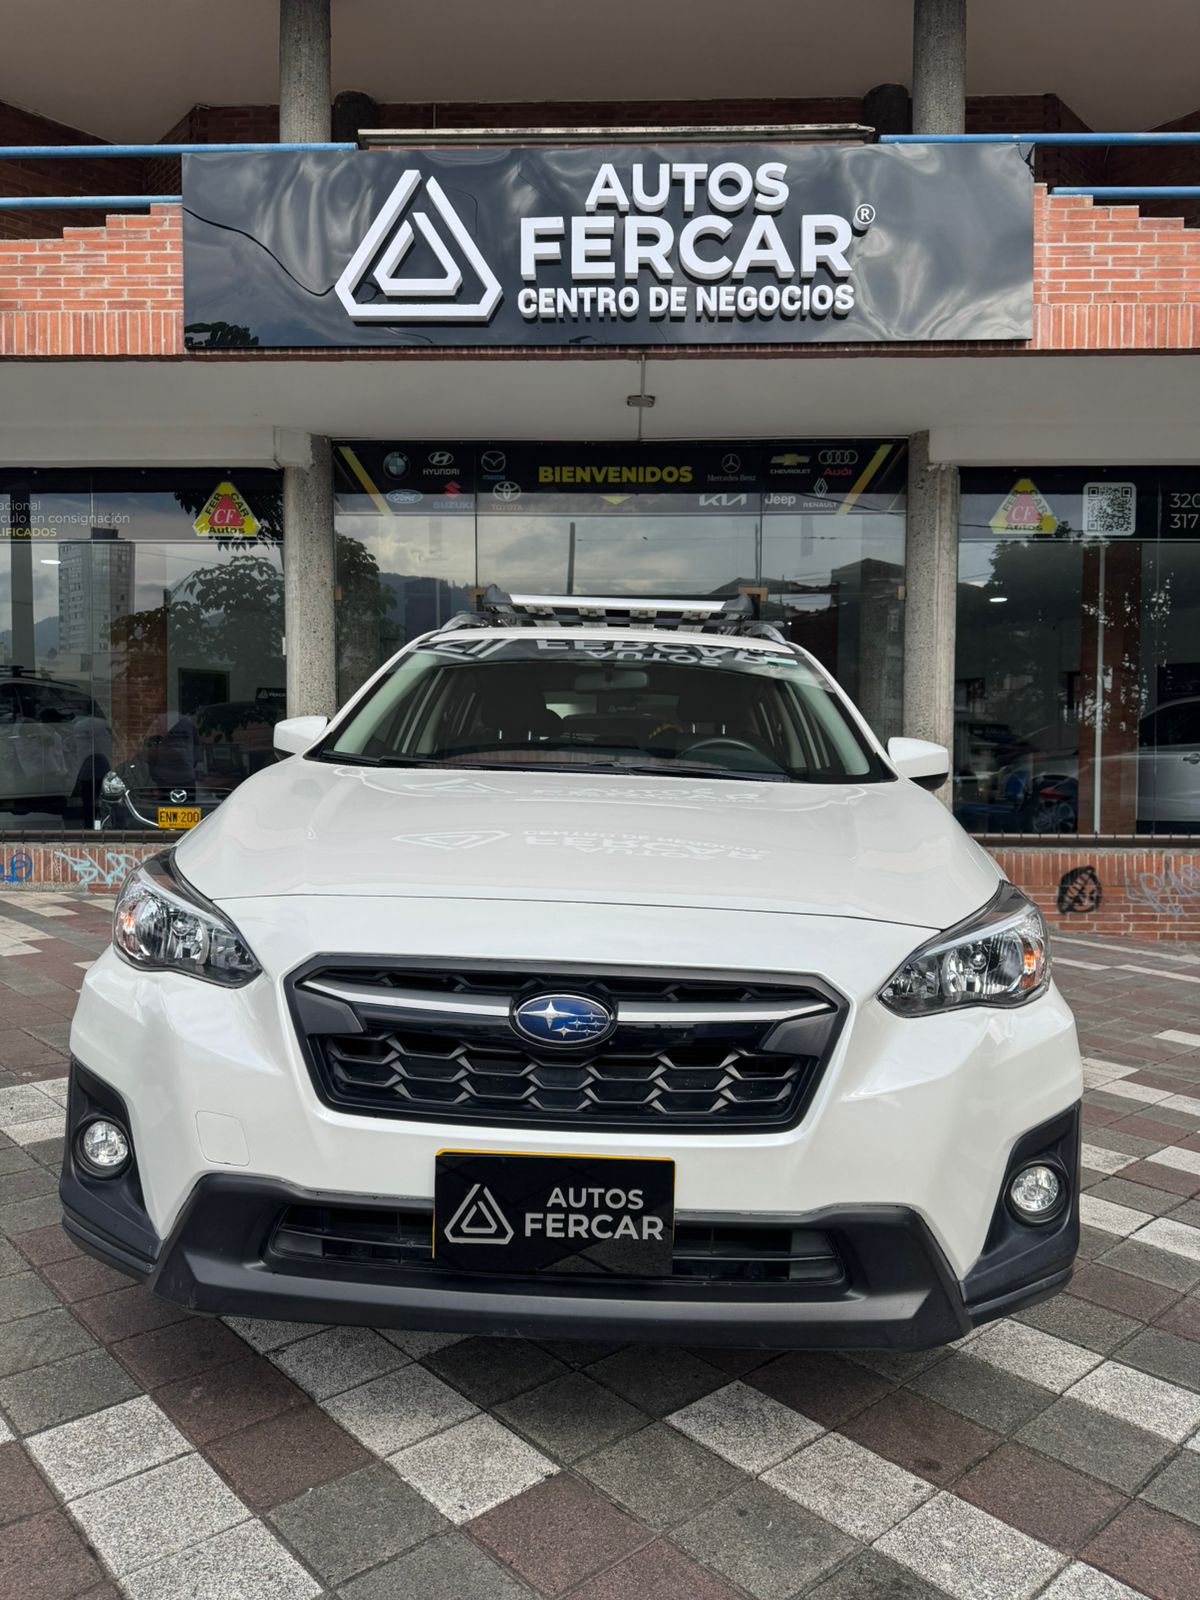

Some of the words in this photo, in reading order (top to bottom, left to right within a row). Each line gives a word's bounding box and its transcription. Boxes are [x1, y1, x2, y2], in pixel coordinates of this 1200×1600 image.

[585, 162, 790, 212] AUTOS
[520, 214, 854, 281] FERCAR
[517, 287, 639, 319] CENTRO
[649, 286, 689, 318] DE
[696, 284, 855, 317] NEGOCIOS
[422, 468, 460, 476] HYUNDAI
[538, 465, 693, 483] BIENVENIDOS
[823, 467, 852, 476] Audi
[432, 501, 474, 510] SUZUKI
[764, 493, 796, 507] Jeep
[1170, 493, 1200, 508] 320
[30, 515, 45, 523] en
[48, 513, 130, 526] consignación
[1170, 513, 1199, 529] 317
[0, 527, 57, 537] IFICADOS
[546, 1187, 644, 1210] AUTOS
[525, 1212, 664, 1241] FERCAR
